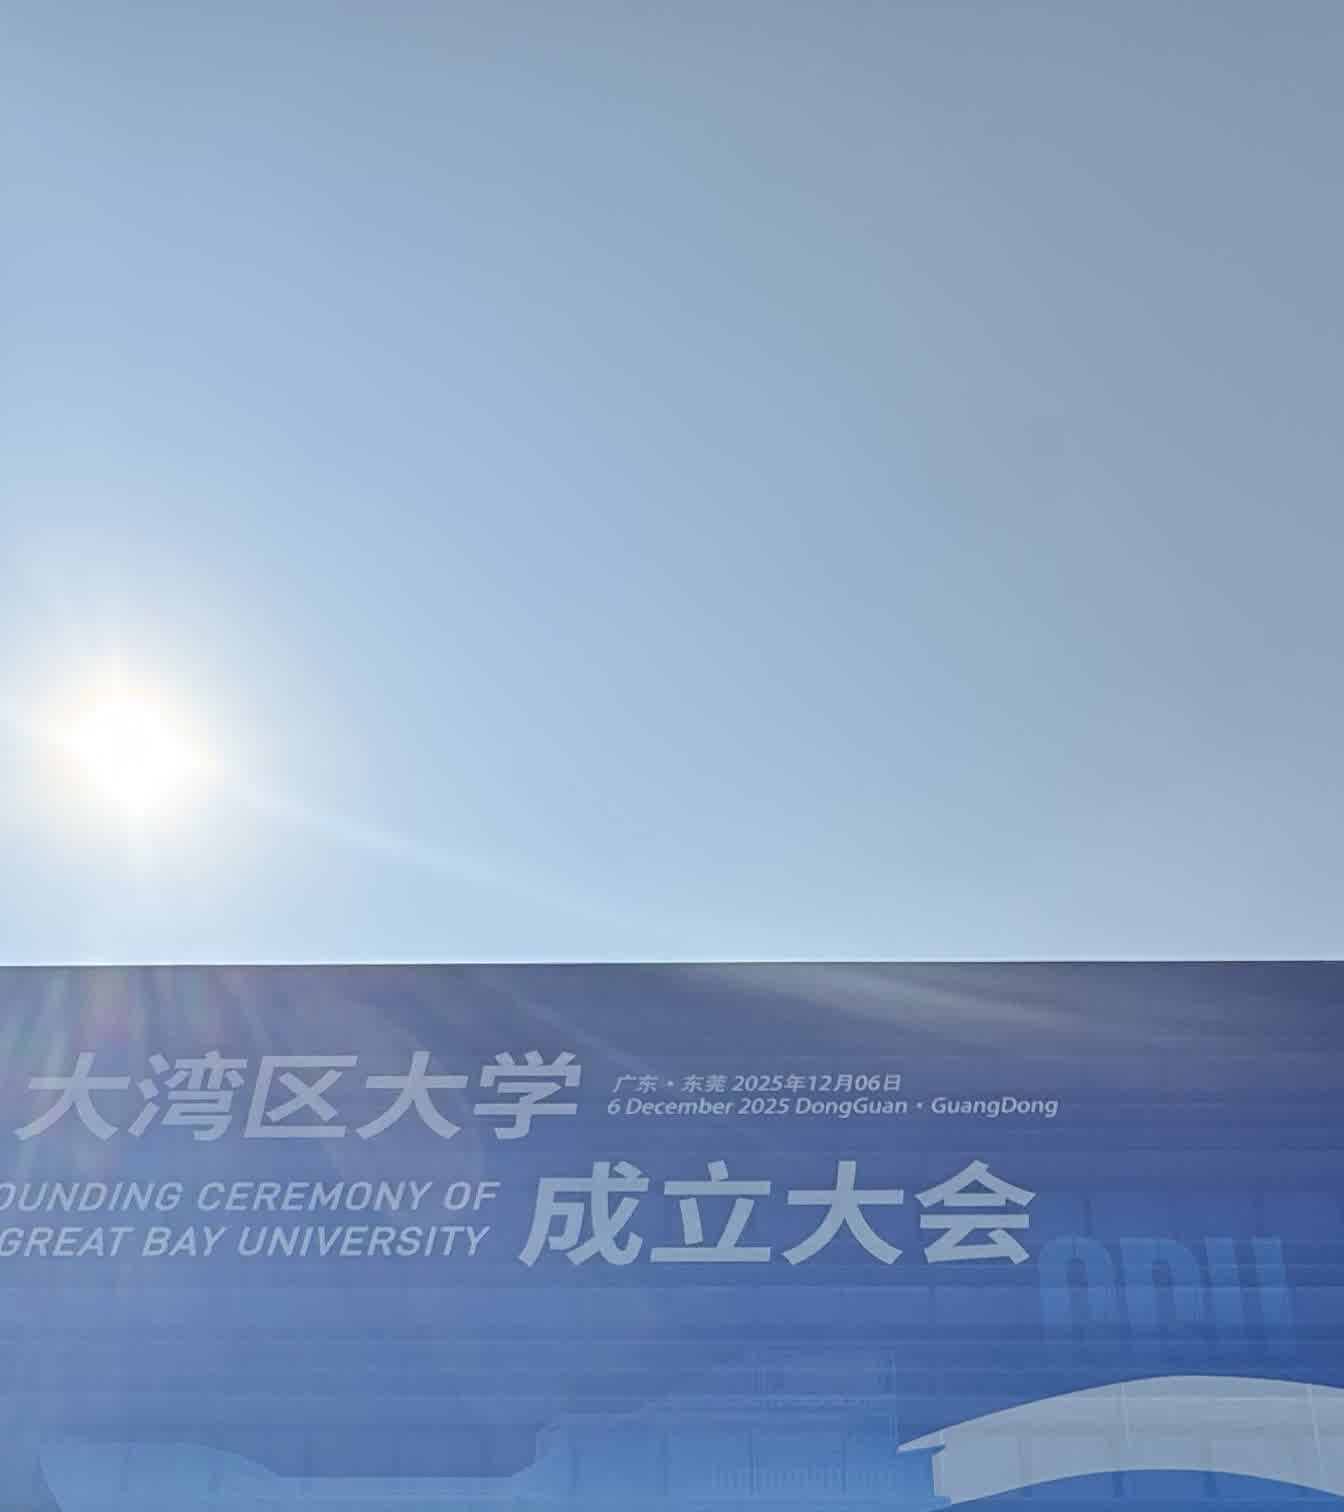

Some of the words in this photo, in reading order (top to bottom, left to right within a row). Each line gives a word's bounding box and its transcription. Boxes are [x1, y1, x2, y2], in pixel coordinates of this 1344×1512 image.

[13, 1050, 582, 1141] 大湾区大学
[731, 1074, 902, 1093] 2025年12月06日
[607, 1098, 621, 1115] 6
[625, 1098, 734, 1115] December
[737, 1098, 790, 1115] 2025
[795, 1098, 908, 1119] DongGuan
[931, 1097, 1059, 1118] GuangDong
[197, 1181, 434, 1211] CEREMONY
[443, 1181, 501, 1211] OF
[519, 1159, 1037, 1267] 成立大会
[141, 1226, 227, 1257] BAY
[238, 1225, 492, 1257] UNIVERSITY
